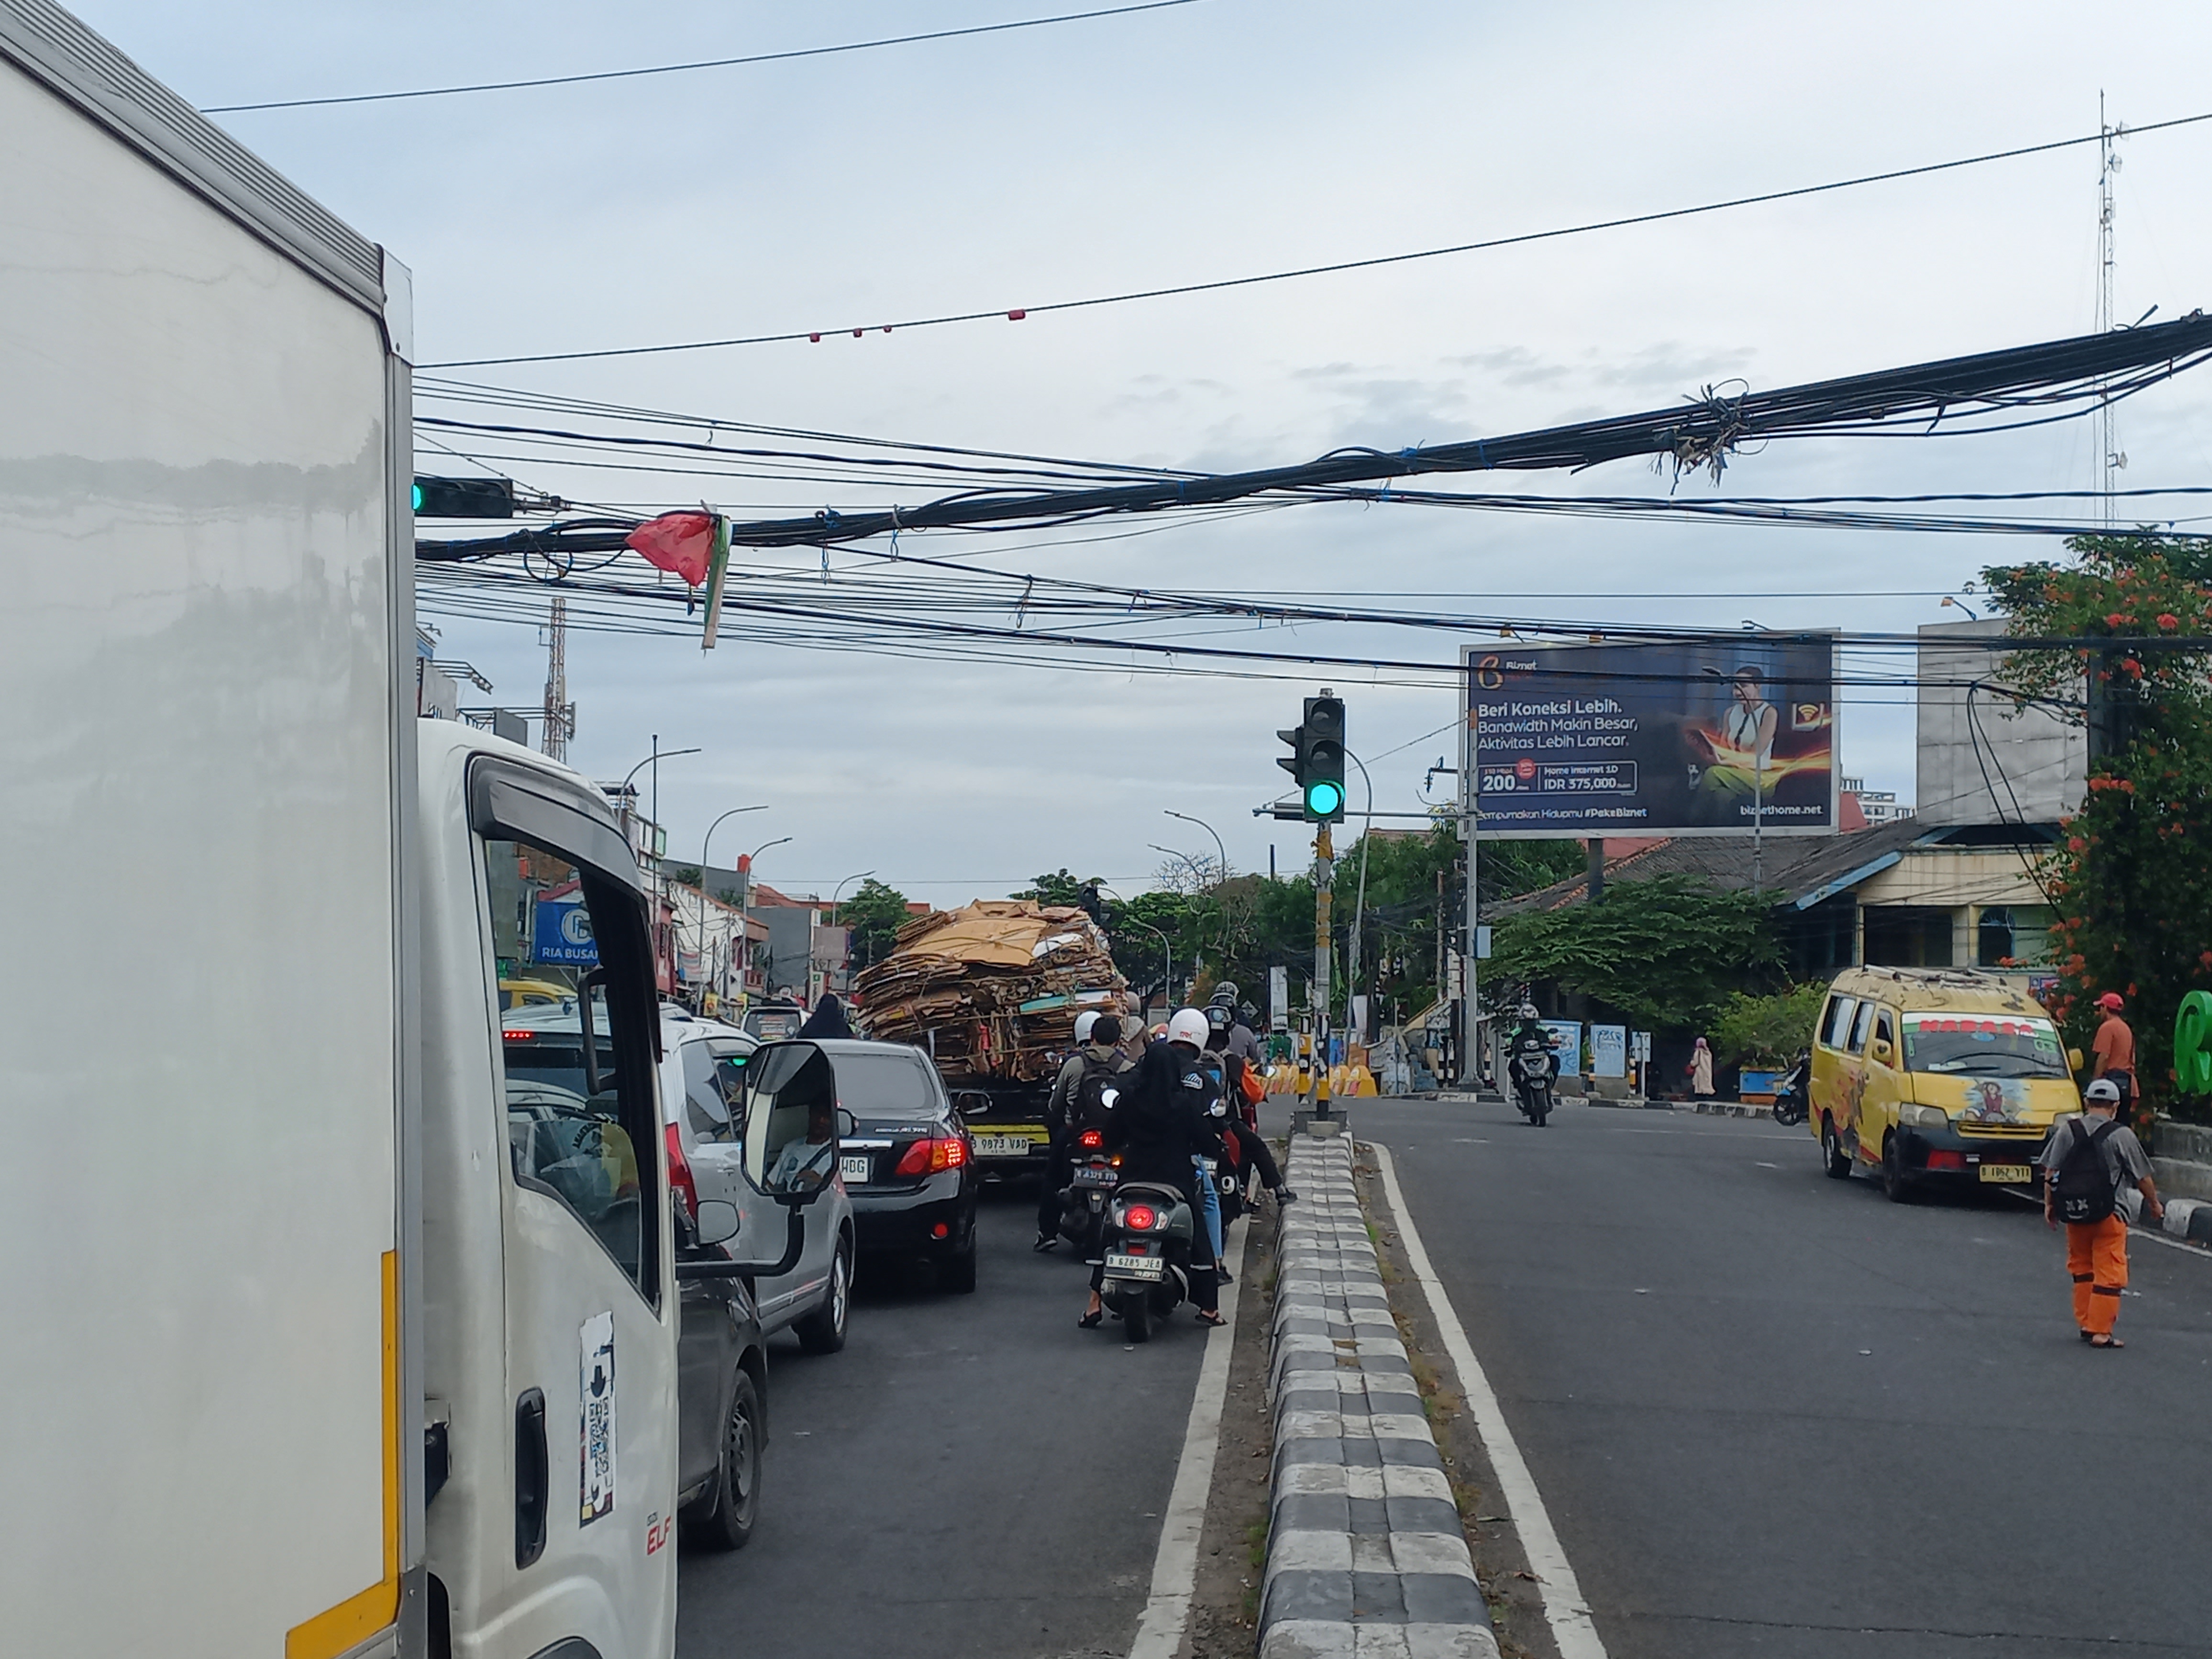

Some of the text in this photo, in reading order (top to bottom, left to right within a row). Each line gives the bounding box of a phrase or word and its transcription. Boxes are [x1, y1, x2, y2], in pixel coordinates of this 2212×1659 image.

[1478, 698, 1623, 717] Beri Koneksi Lebih.
[1478, 717, 1638, 734] Bandwidth Makin Besar,
[1478, 734, 1629, 750] Aktivitas Lebih Lancar.
[1483, 774, 1515, 791] 200
[1544, 778, 1566, 790] IDR
[1569, 777, 1616, 791] 375,000
[1584, 807, 1647, 818] #PakeBiznet
[542, 947, 563, 958] RIA
[981, 1139, 1005, 1150] 9873
[647, 1515, 671, 1556] ELF
